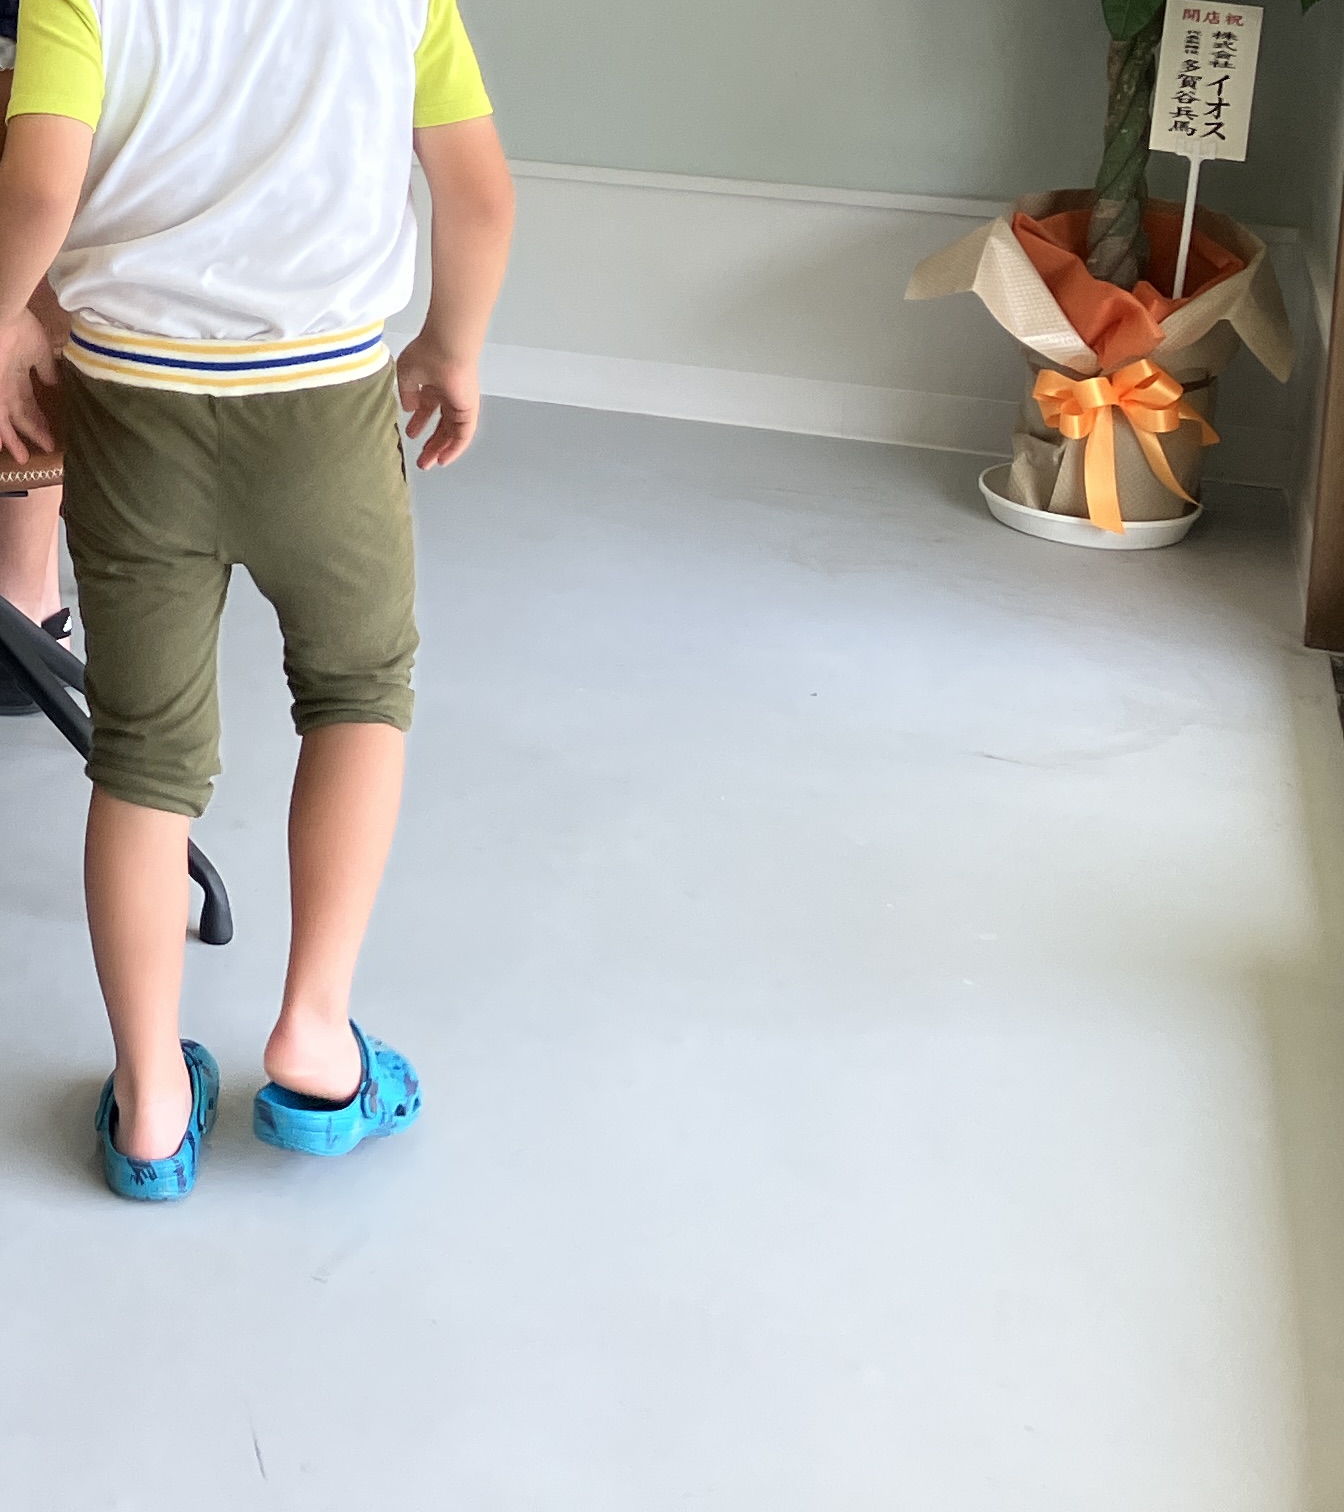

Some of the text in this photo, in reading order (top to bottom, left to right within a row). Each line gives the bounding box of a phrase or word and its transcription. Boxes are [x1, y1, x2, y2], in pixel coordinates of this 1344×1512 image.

[1182, 9, 1244, 27] 開店祝
[1200, 31, 1239, 141] 株式会社 イオス
